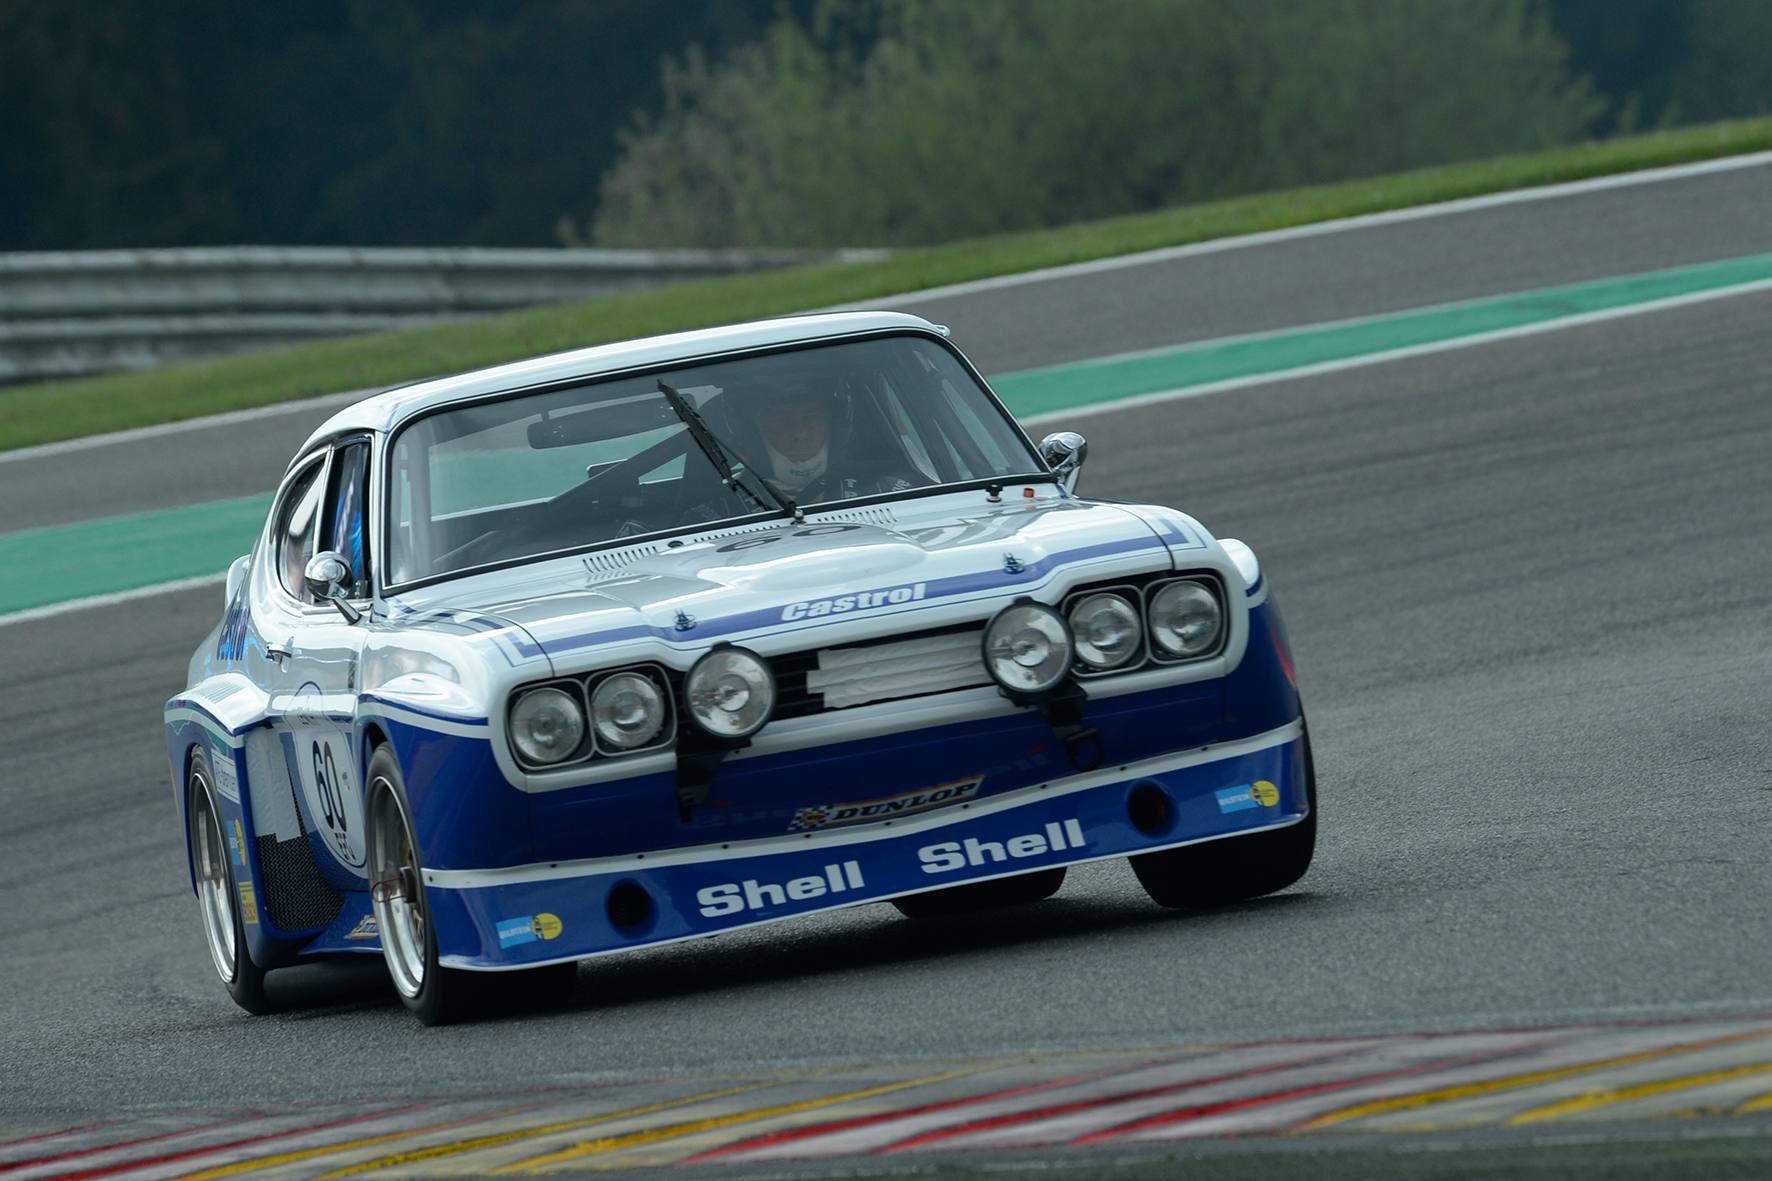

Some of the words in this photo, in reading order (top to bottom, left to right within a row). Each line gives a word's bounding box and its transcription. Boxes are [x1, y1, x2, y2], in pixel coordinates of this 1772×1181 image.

[781, 582, 926, 622] Castrol
[312, 740, 347, 832] 60
[831, 782, 978, 821] DUNLOP
[917, 818, 1086, 874] Shell
[696, 860, 865, 918] Shell
